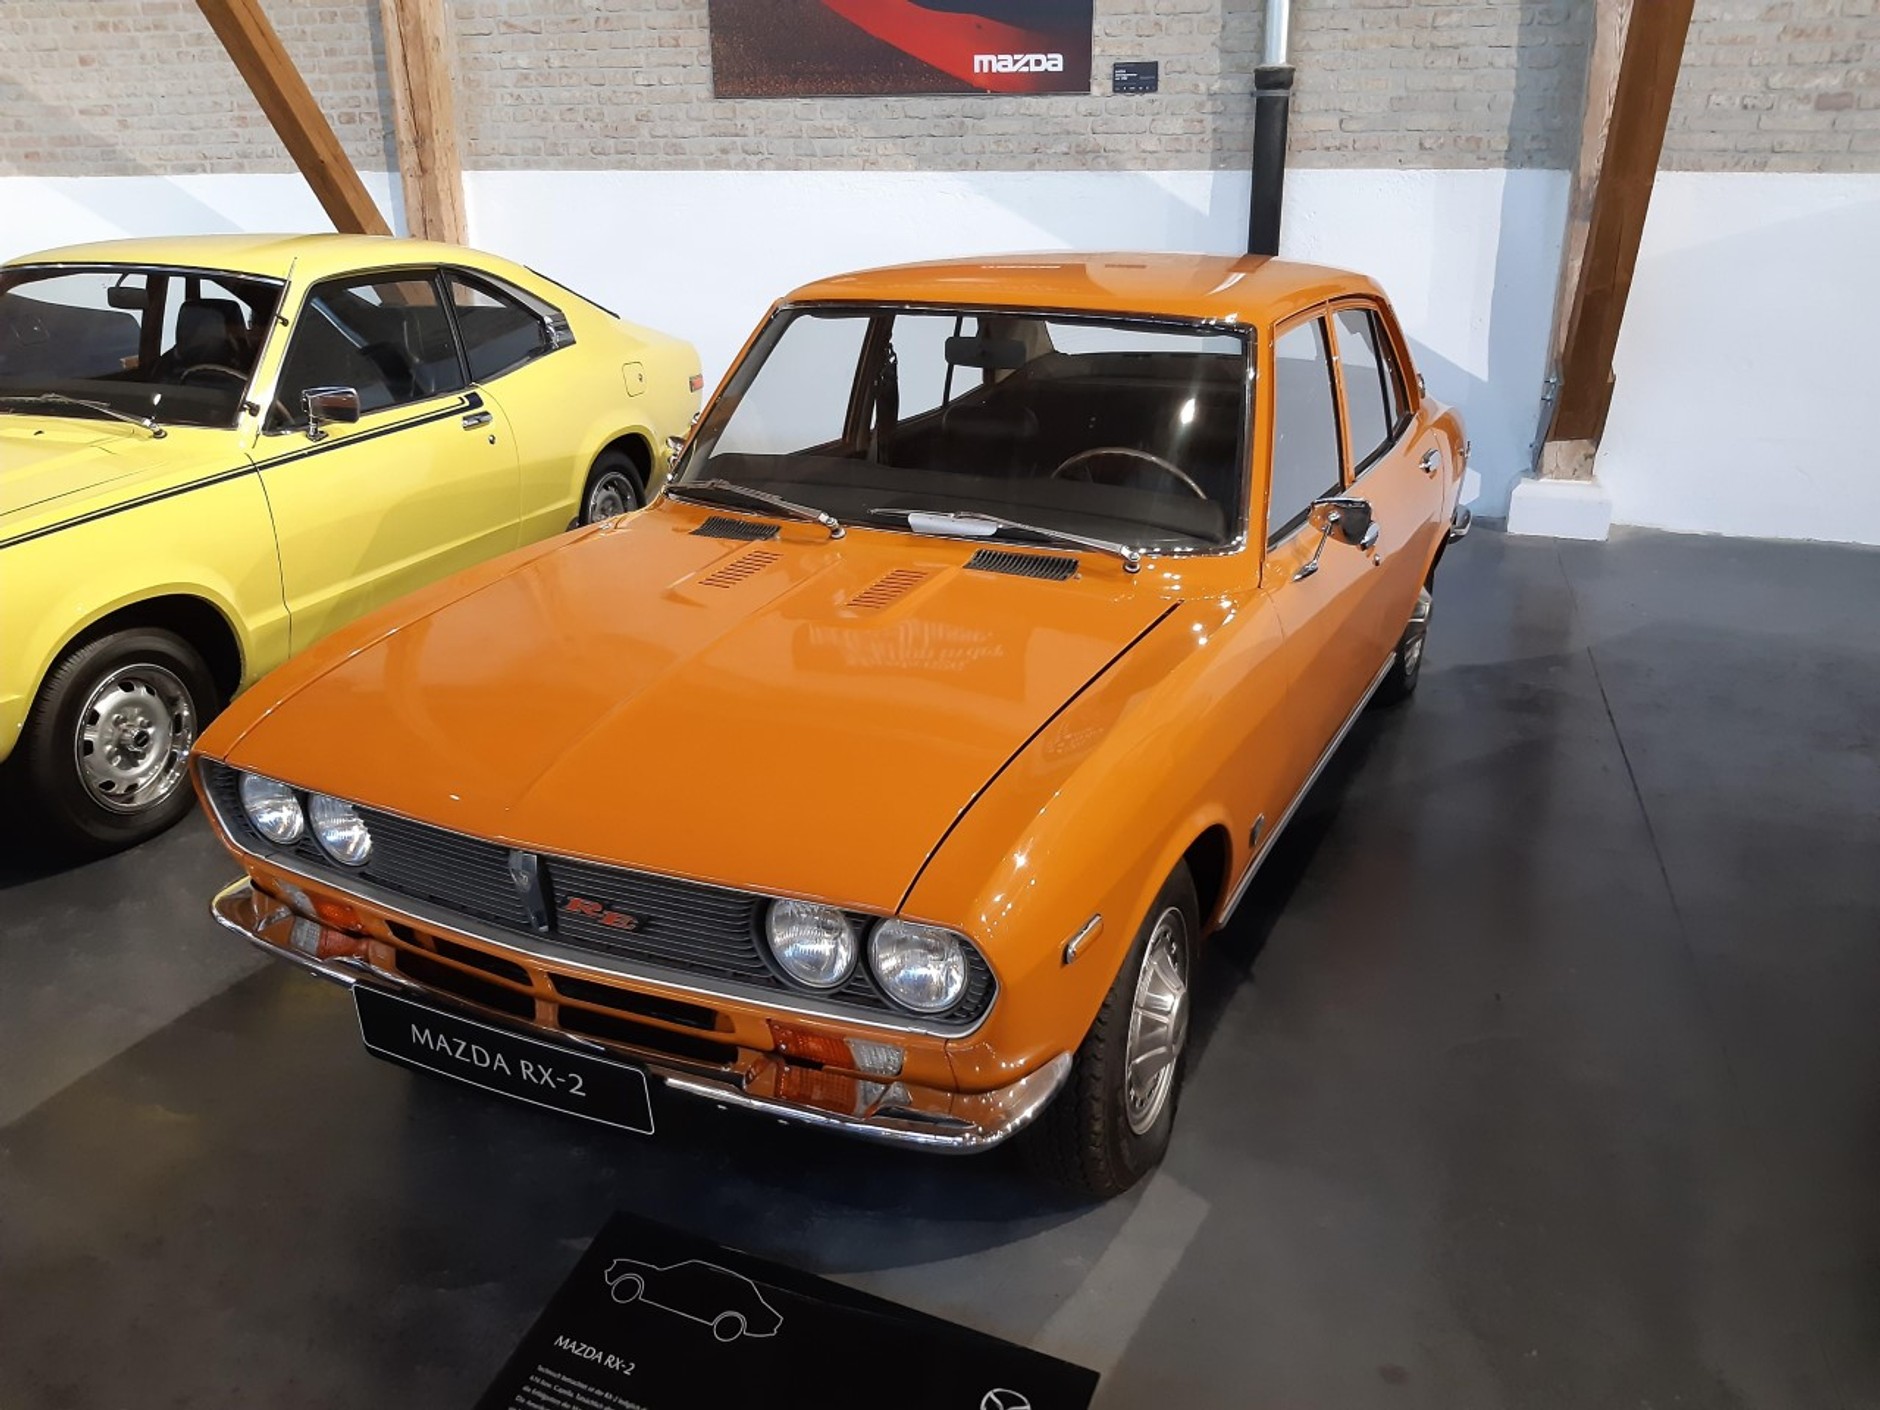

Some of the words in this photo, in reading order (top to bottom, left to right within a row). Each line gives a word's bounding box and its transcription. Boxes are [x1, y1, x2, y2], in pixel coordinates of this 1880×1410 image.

[411, 1024, 511, 1076] MAZDA
[519, 1059, 587, 1097] RX-2
[554, 1335, 602, 1363] MAZDA
[603, 1354, 636, 1376] RX-2
